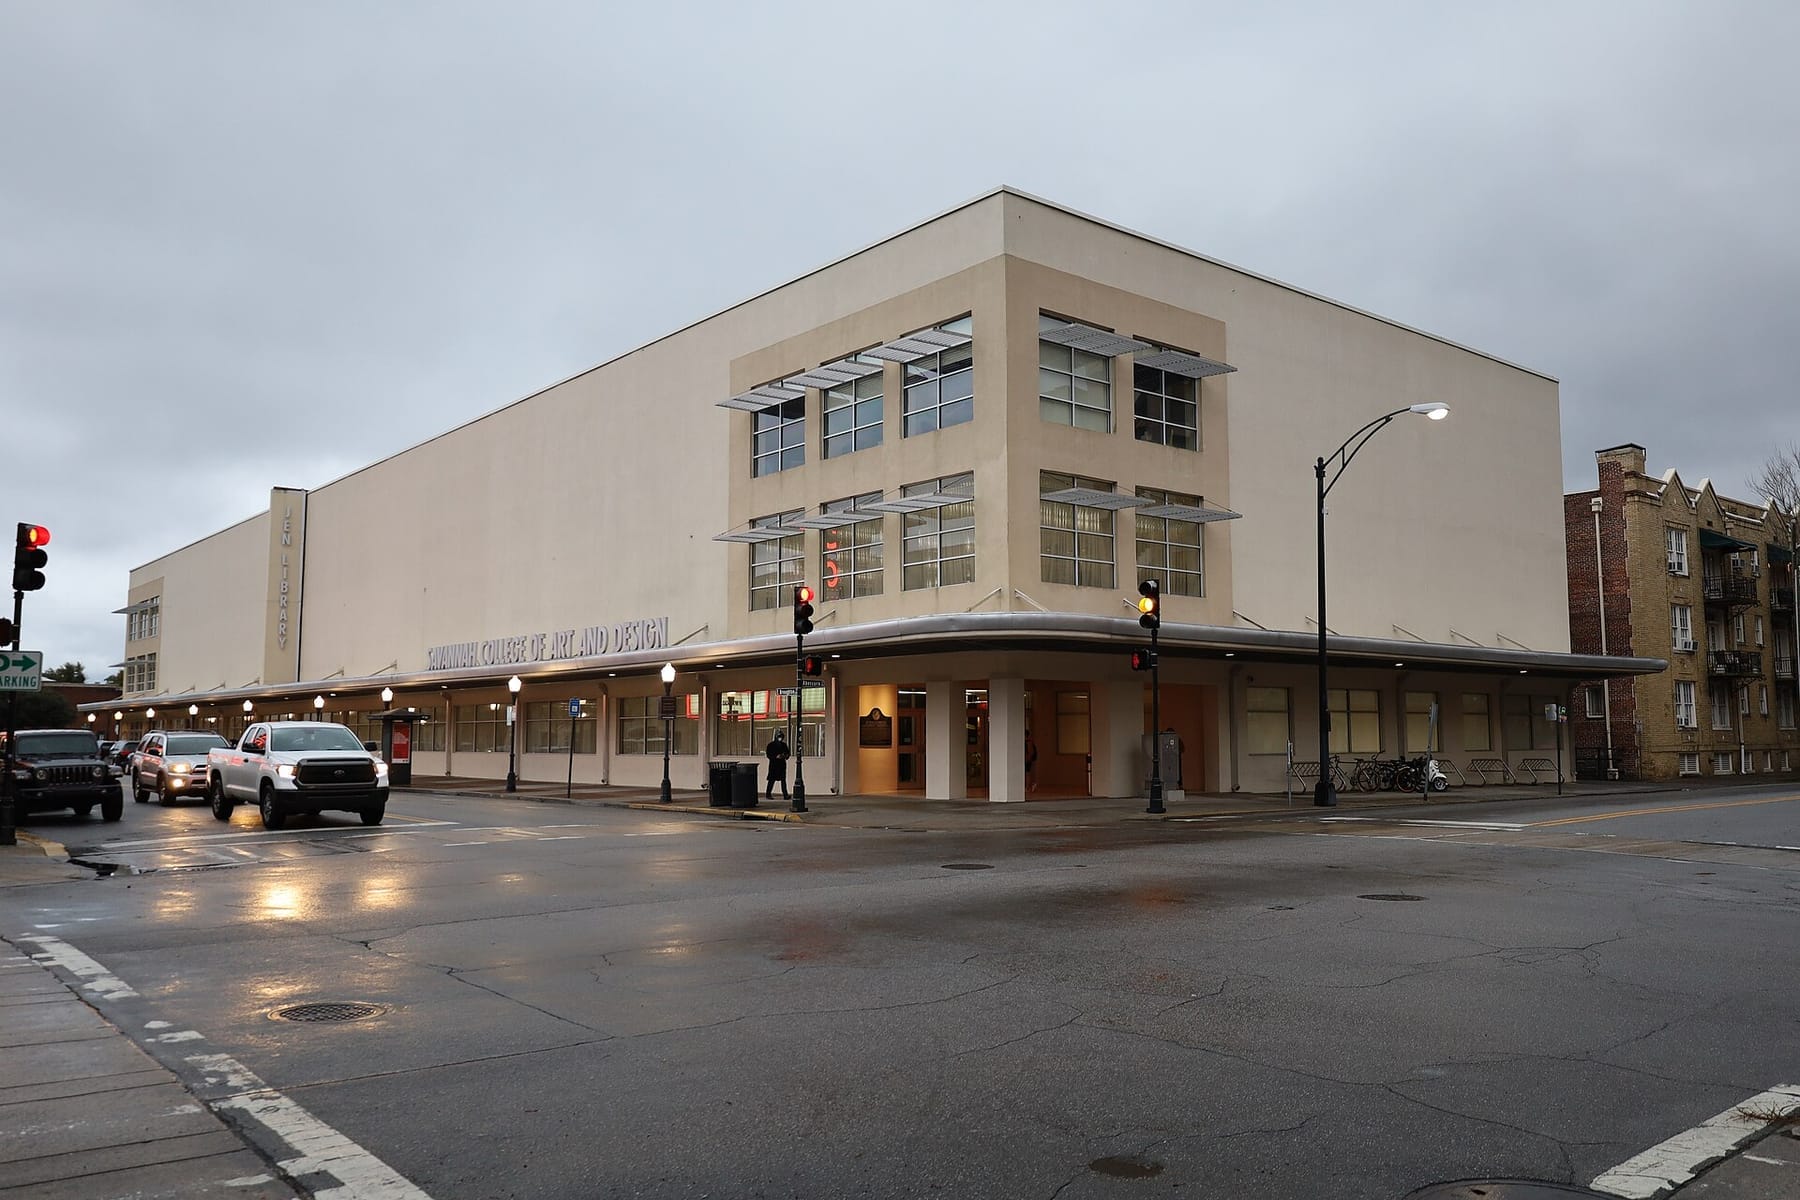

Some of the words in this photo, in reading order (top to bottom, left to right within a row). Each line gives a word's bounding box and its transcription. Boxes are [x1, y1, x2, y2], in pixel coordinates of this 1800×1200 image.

[282, 508, 291, 545] JEN
[278, 555, 289, 649] LIBRARY
[428, 642, 478, 671] SAVANNAH
[481, 635, 527, 665] COLLEGE
[530, 633, 547, 662] OF
[551, 630, 575, 660] ART
[580, 626, 608, 656] AND
[614, 618, 668, 652] DESIGN
[0, 676, 37, 687] ARKING
